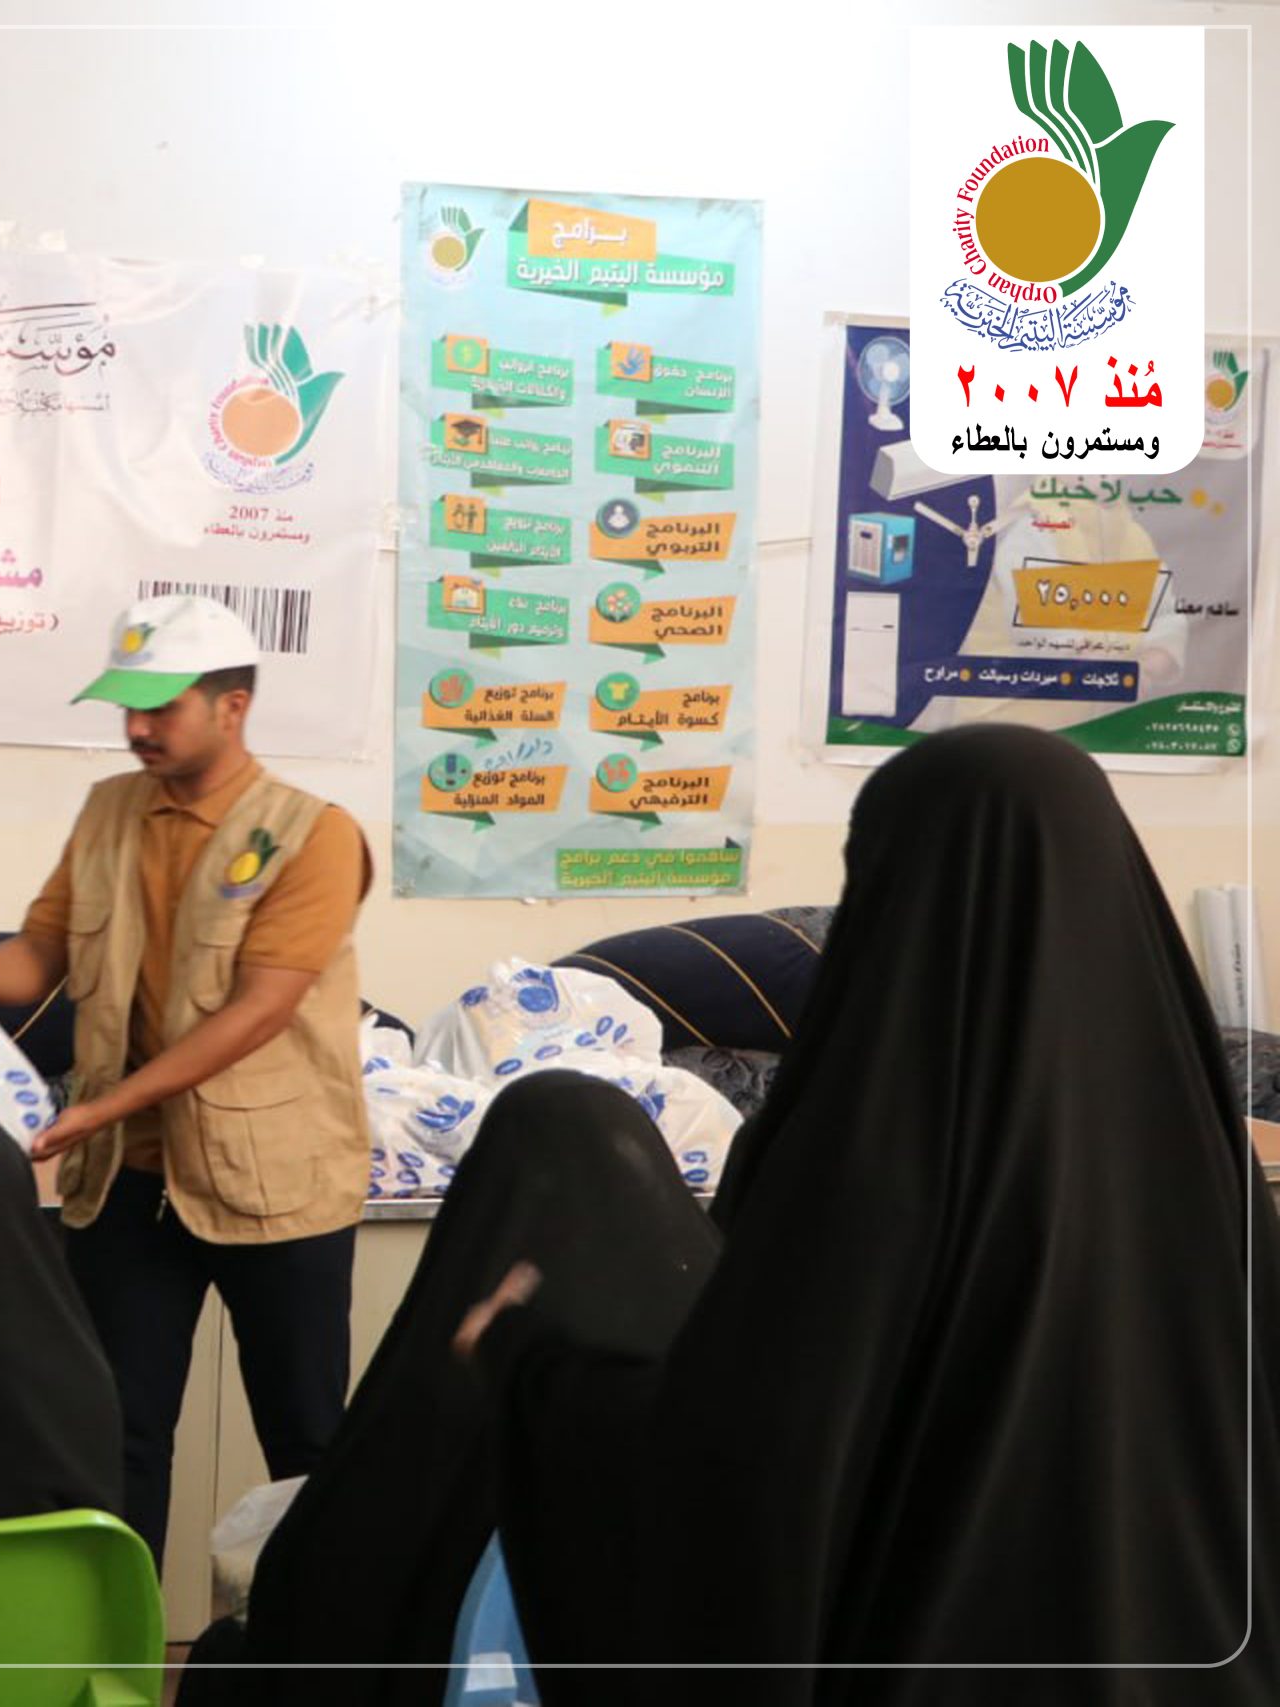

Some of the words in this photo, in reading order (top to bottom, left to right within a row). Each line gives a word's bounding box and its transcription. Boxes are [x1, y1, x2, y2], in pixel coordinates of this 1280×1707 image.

[517, 256, 580, 286] الخيرية
[589, 262, 640, 286] اليتيم
[646, 262, 726, 292] مؤسسة
[660, 443, 720, 459] البرنامج
[1128, 486, 1183, 512] حب
[229, 505, 270, 521] 2007
[646, 522, 720, 538] البرنامج
[646, 540, 720, 555] التربوي
[651, 605, 723, 622] البرنامج
[654, 624, 723, 640] الصحي
[924, 665, 959, 682] مراوح
[1020, 669, 1057, 687] مبردات
[1081, 672, 1119, 689] ثلاجات
[484, 687, 517, 704] توزيع
[520, 688, 554, 703] برنامج
[682, 690, 720, 708] برنامج
[677, 712, 719, 728] كسوة
[472, 771, 506, 788] توزيع
[509, 770, 546, 788] برنامج
[642, 776, 710, 792] البرنامج
[629, 794, 708, 810] الترفيهي
[559, 850, 602, 869] برامج
[607, 852, 641, 866] دعم
[645, 853, 675, 867] في
[680, 850, 740, 866] ساهموا
[623, 872, 661, 888] اليتيم
[671, 873, 732, 887] مؤسسة
